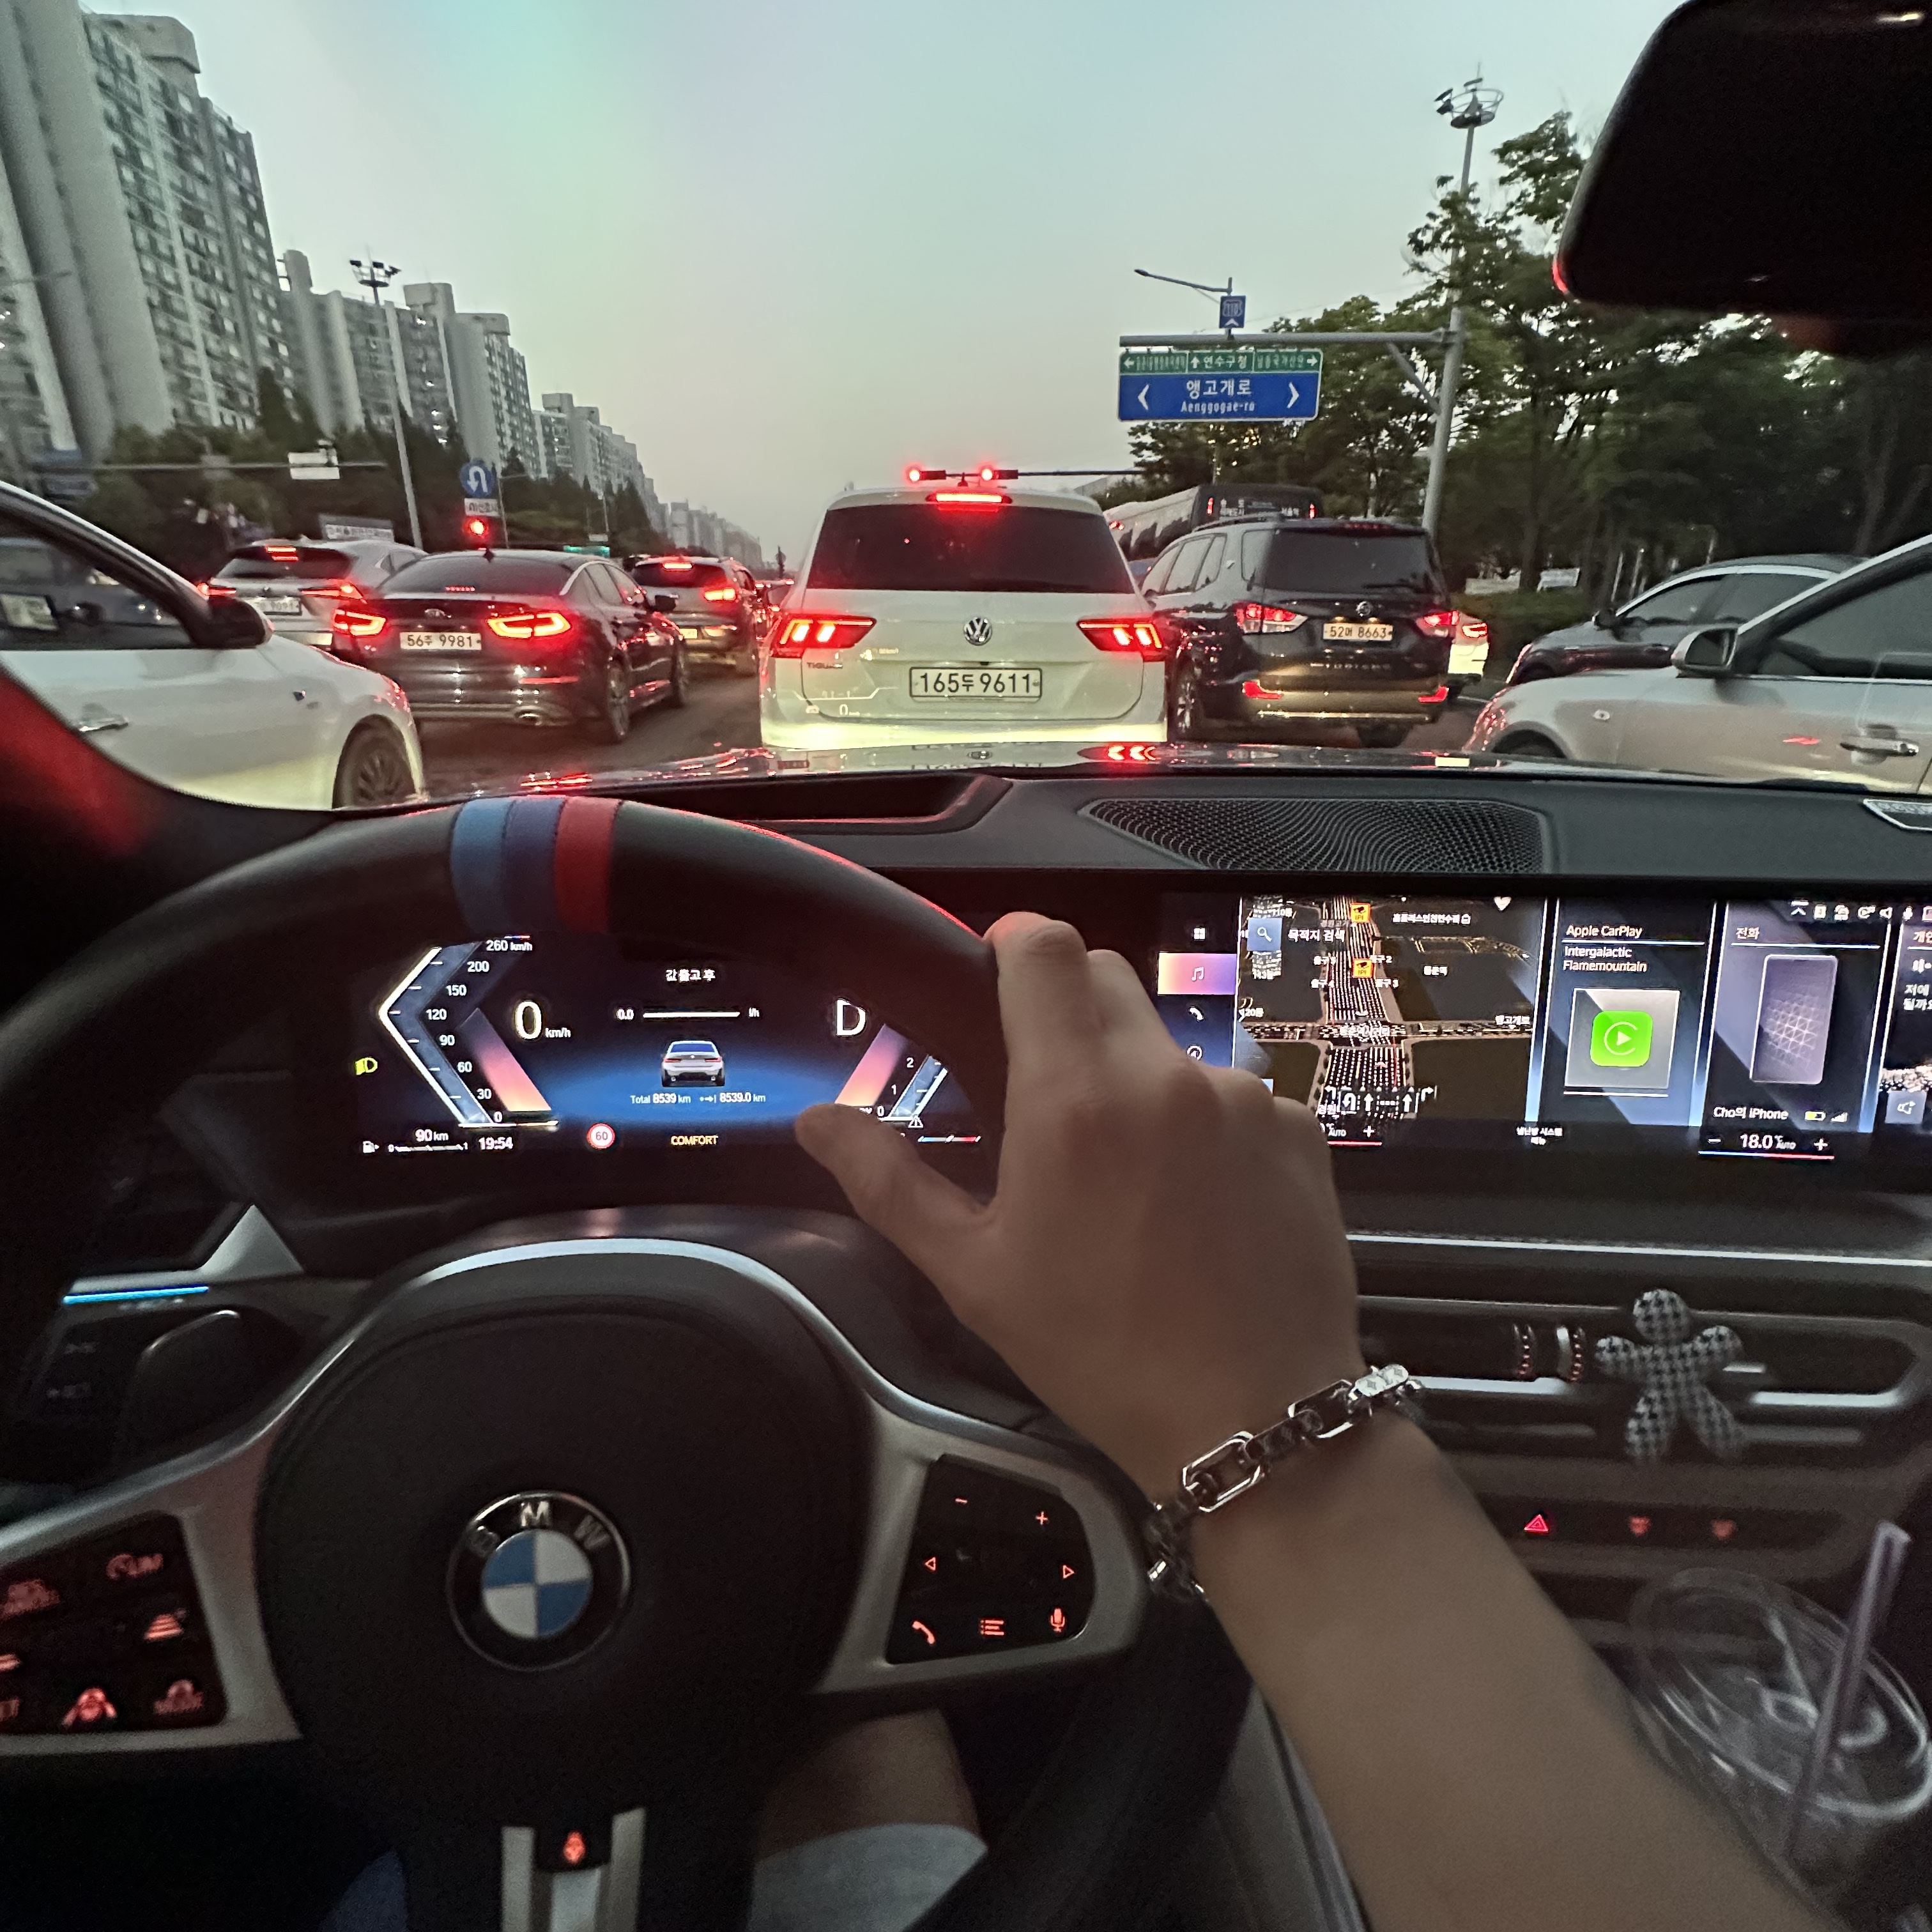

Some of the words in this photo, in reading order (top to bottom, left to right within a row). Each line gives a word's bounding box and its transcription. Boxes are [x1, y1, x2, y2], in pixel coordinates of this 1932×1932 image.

[1186, 379, 1252, 399] 앵고개로
[1181, 401, 1255, 415] Aenggogae-ro
[1358, 626, 1386, 639] 8663
[407, 634, 433, 647] 56주
[439, 634, 472, 648] 9981
[920, 672, 974, 693] 165두
[979, 673, 1030, 694] 9611
[1288, 928, 1320, 943] 목적지
[1323, 928, 1345, 943] 검색
[1566, 924, 1600, 938] Apple
[1600, 924, 1643, 939] CarPlay
[1735, 927, 1759, 940] 전화
[486, 940, 508, 951] 260
[510, 942, 533, 951] km/h
[1564, 946, 1633, 959] Intergalactic
[467, 961, 490, 972] 200
[1563, 960, 1648, 972] Flamemountain
[447, 985, 467, 996] 150
[425, 1009, 447, 1020] 120
[515, 1000, 542, 1039] 0
[545, 1027, 571, 1038] km/h
[617, 1009, 634, 1020] 0.0
[836, 998, 866, 1036] D
[439, 1035, 456, 1046] 90
[457, 1061, 473, 1073] 60
[906, 1057, 914, 1068] 2
[477, 1088, 492, 1100] 30
[891, 1084, 898, 1095] 1
[631, 1095, 651, 1104] Total
[652, 1093, 677, 1104] 8539
[678, 1094, 691, 1104] km
[719, 1092, 752, 1103] 8539.0
[753, 1093, 766, 1103] km
[494, 1112, 503, 1122] 0
[877, 1106, 885, 1117] 0
[1713, 1107, 1747, 1119] Cho의
[1749, 1107, 1789, 1120] iPhone
[415, 1129, 433, 1142] 90
[433, 1131, 448, 1141] km
[595, 1131, 609, 1141] 60
[1328, 1128, 1347, 1137] AUTO
[464, 1142, 468, 1150] 1
[479, 1137, 514, 1151] 19:54
[671, 1135, 719, 1146] COMFORT
[1740, 1133, 1773, 1149] 18.0
[388, 1144, 394, 1153] 0
